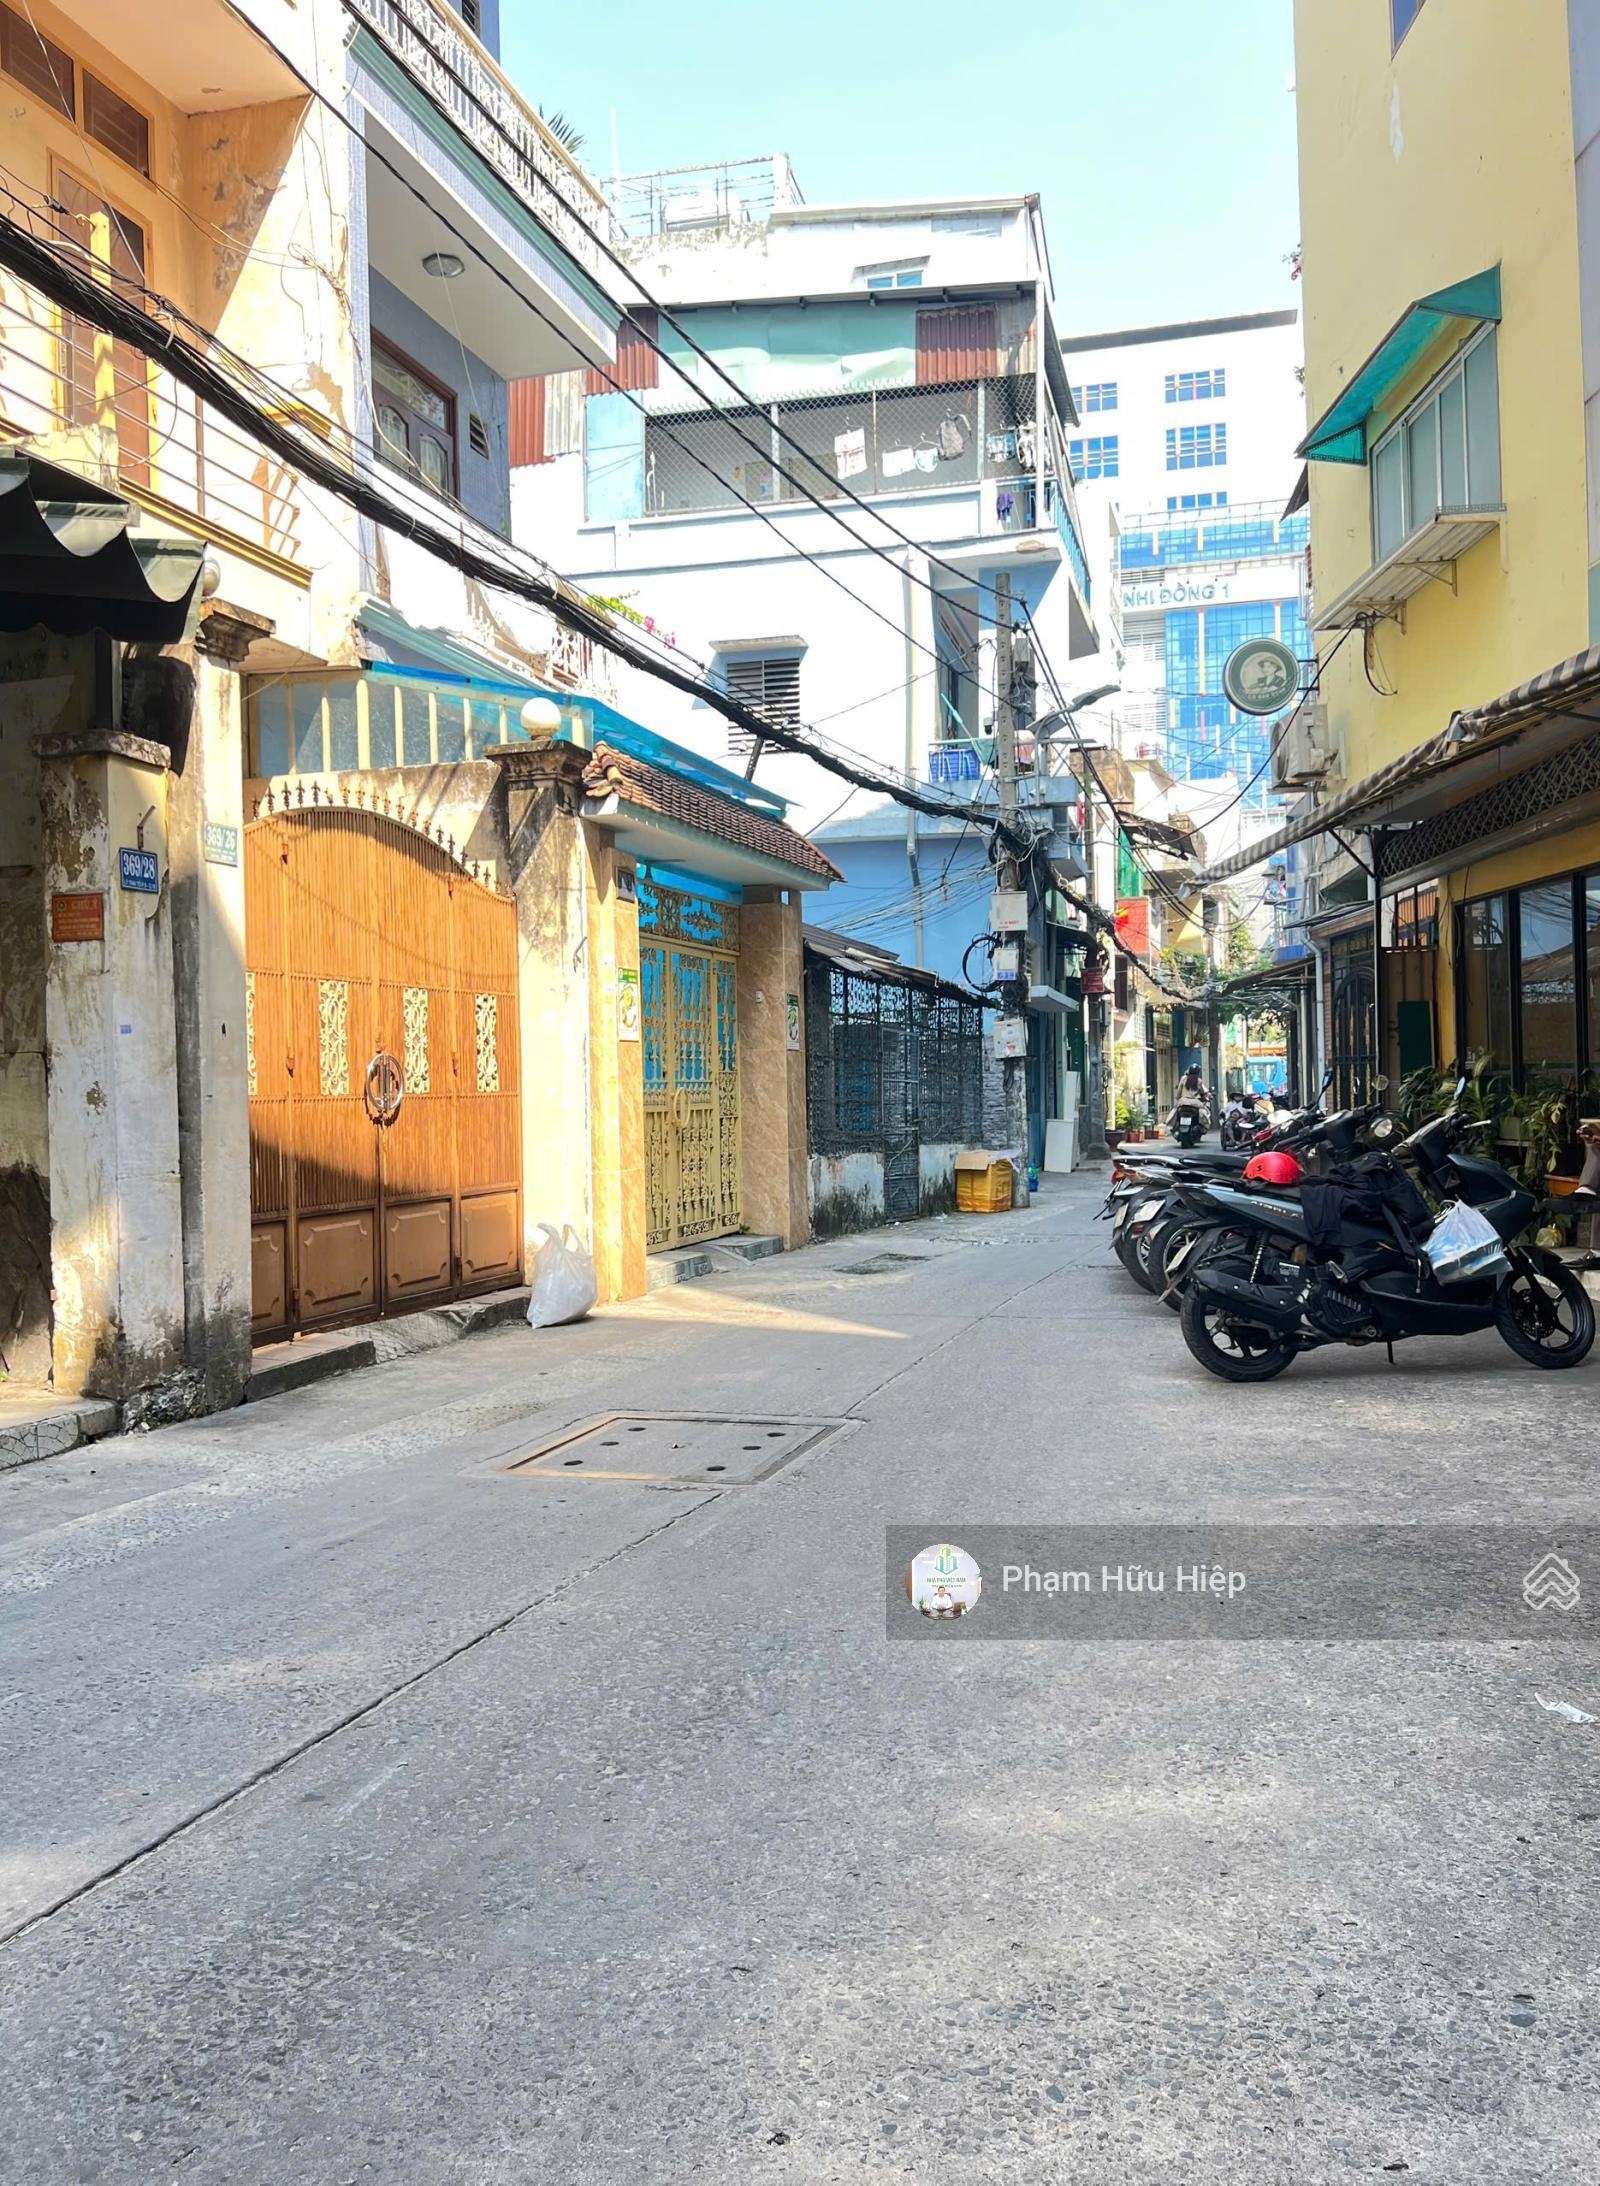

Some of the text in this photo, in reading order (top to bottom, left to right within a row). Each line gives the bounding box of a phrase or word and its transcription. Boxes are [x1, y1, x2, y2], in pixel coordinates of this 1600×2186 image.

[1123, 582, 1229, 607] NHI ĐỒNG 1
[206, 826, 236, 850] 369/26
[123, 853, 155, 879] 369/28
